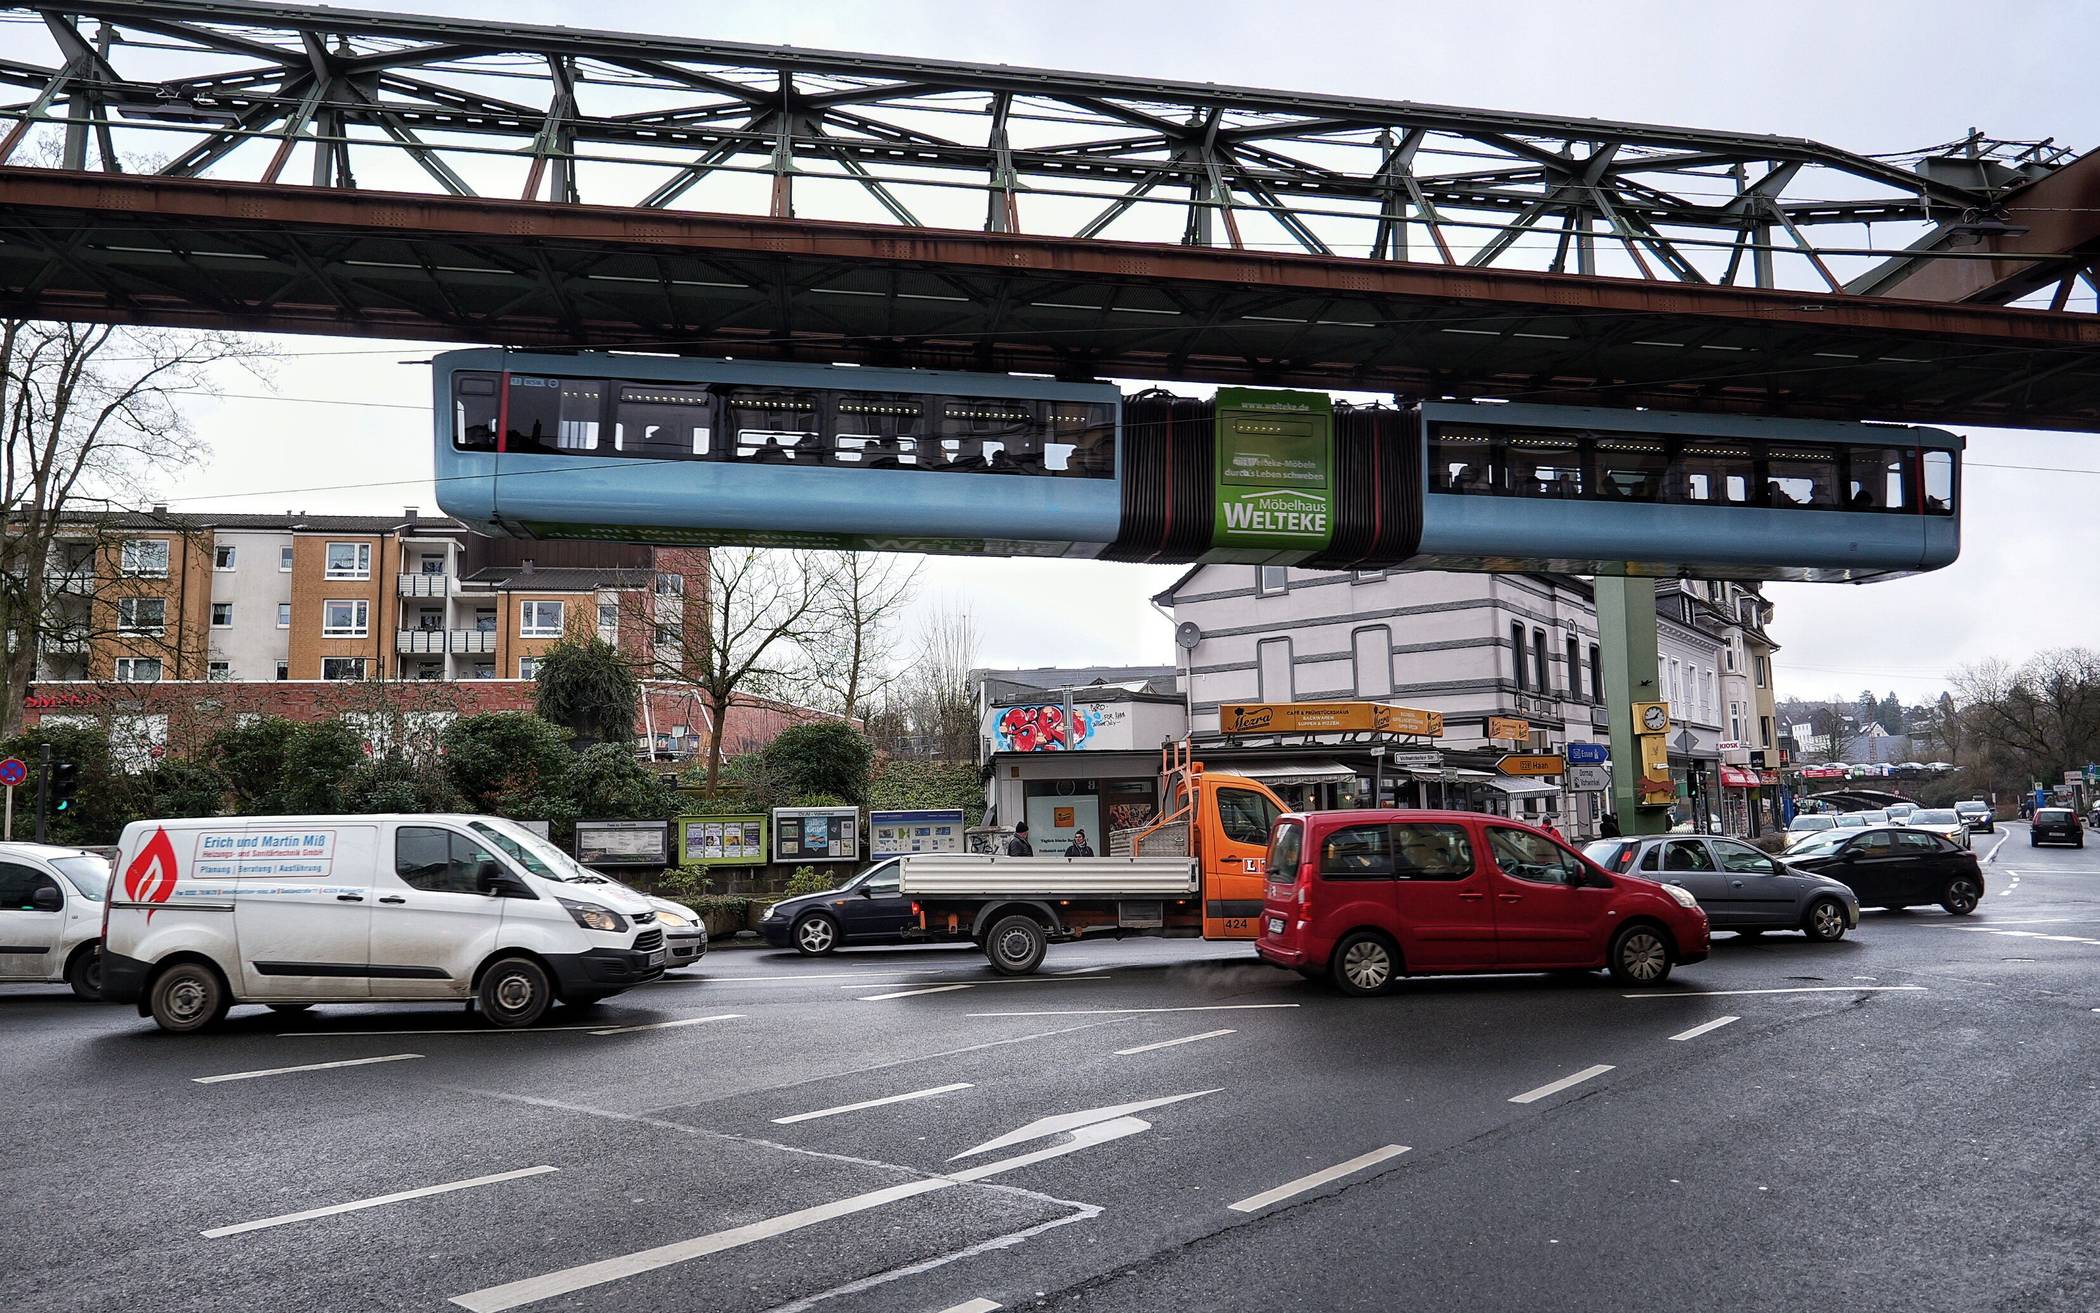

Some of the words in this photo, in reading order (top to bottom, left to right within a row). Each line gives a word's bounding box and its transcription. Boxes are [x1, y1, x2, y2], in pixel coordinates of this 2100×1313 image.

[1241, 402, 1310, 411] www.welteke.de
[1256, 470, 1282, 479] Leben
[1283, 471, 1324, 481] schweben
[1259, 498, 1327, 512] Möbelhaus
[1223, 502, 1327, 532] WELTEKE
[1228, 713, 1271, 731] Mezra
[1720, 742, 1738, 750] KIOSK
[1533, 761, 1549, 769] Haan
[204, 836, 233, 848] Erich
[237, 836, 258, 848] und
[261, 835, 300, 847] Martin
[1225, 920, 1248, 929] 424
